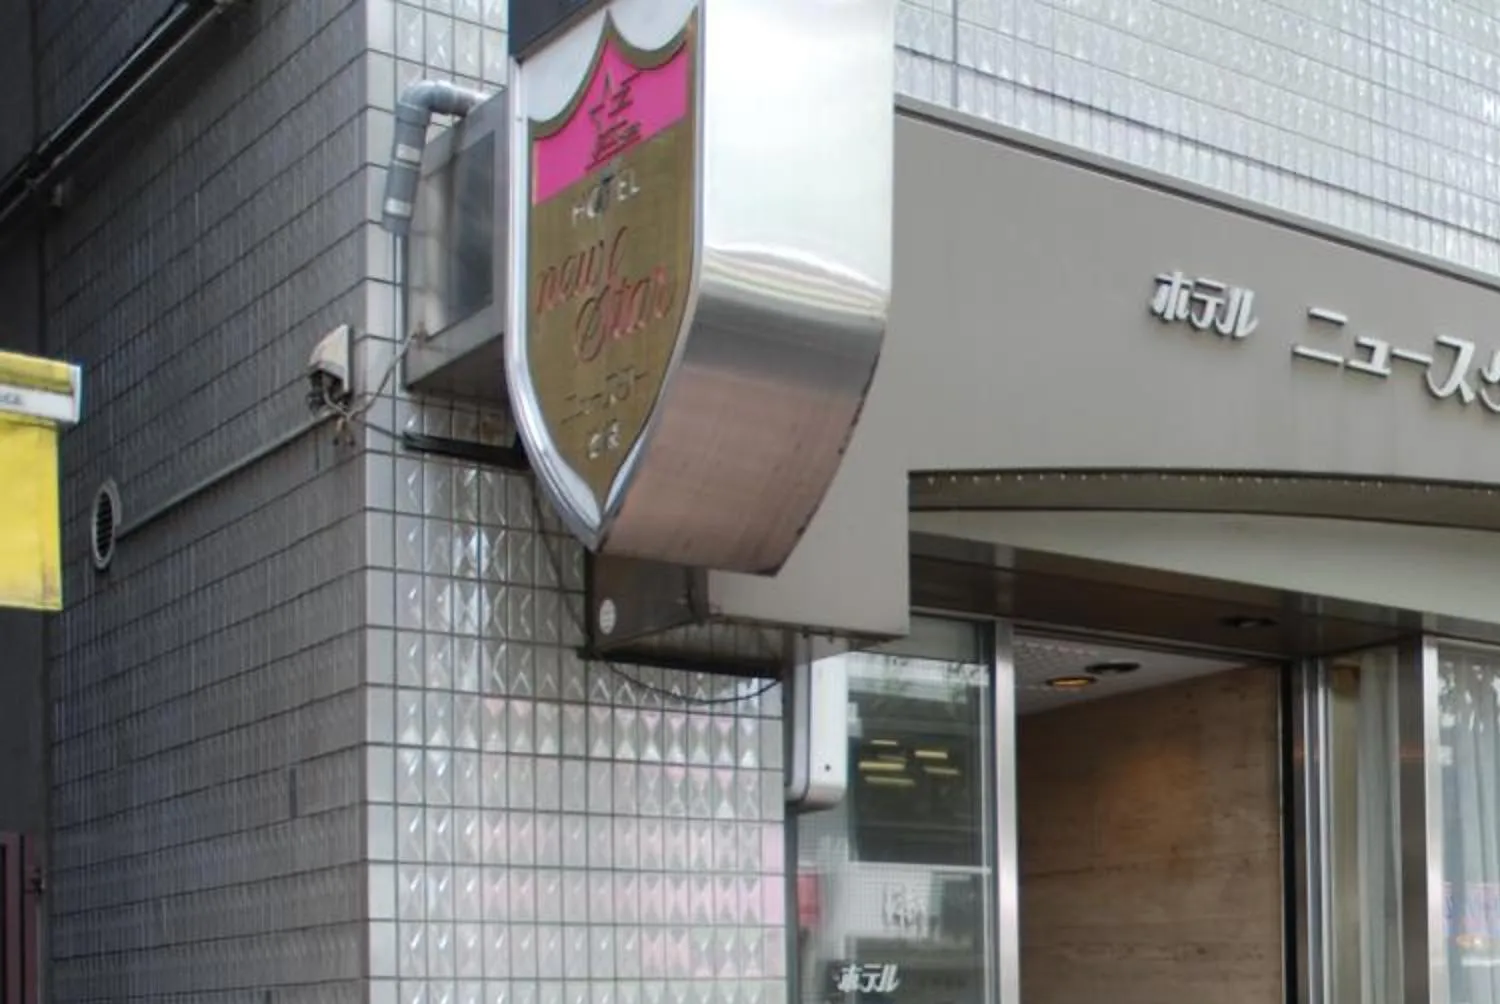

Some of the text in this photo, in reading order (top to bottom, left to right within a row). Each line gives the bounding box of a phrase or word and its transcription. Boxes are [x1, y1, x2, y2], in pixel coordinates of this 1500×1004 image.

[572, 167, 640, 226] HOTEL
[1151, 271, 1259, 338] ホテル
[837, 963, 900, 993] ホテル
